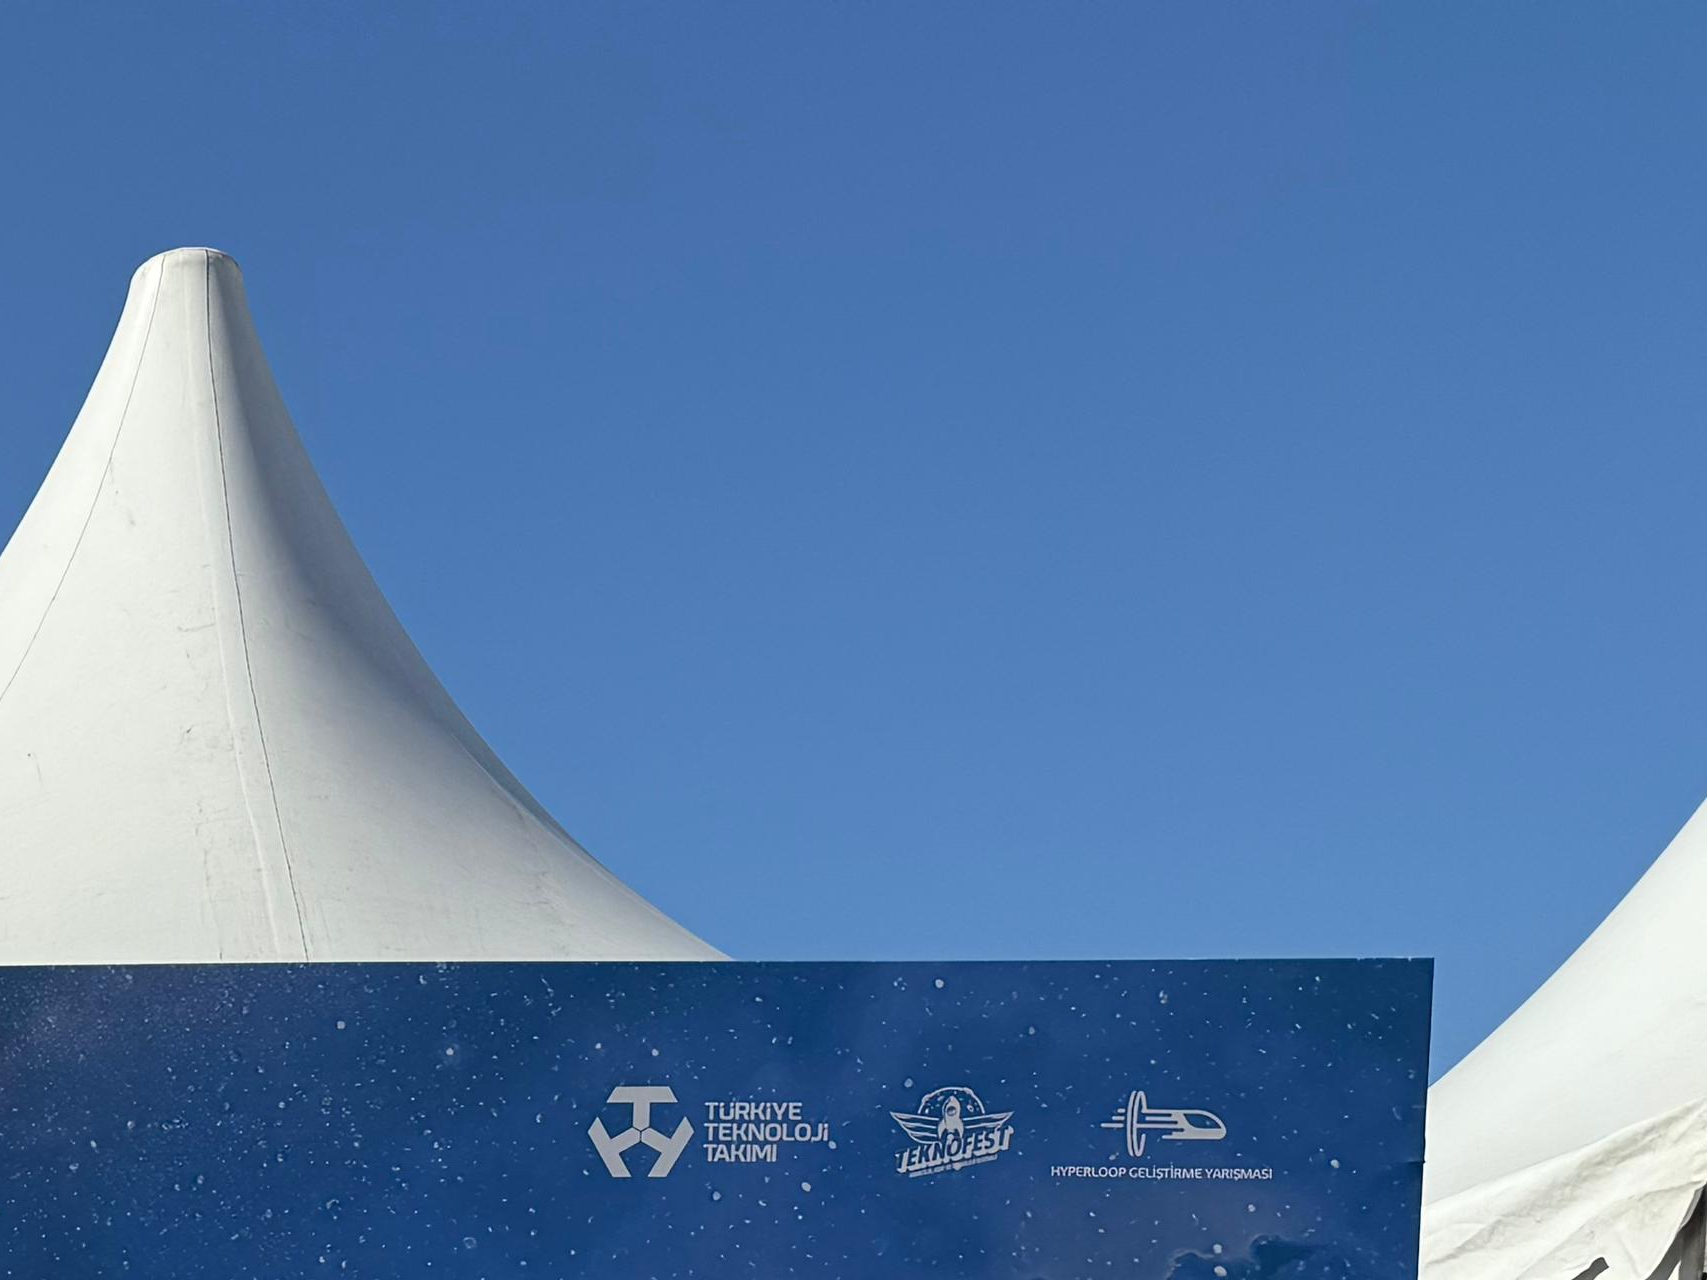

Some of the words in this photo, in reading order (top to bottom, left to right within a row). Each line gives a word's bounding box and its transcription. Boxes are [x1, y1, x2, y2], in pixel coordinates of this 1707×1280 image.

[703, 1144, 777, 1162] TAKIMI
[895, 1125, 1014, 1173] TEKNOFEST
[1051, 1166, 1126, 1178] HYPERLOOP
[1128, 1162, 1203, 1180] GELİŞTİRME
[1205, 1168, 1273, 1181] YARIŞMASI
